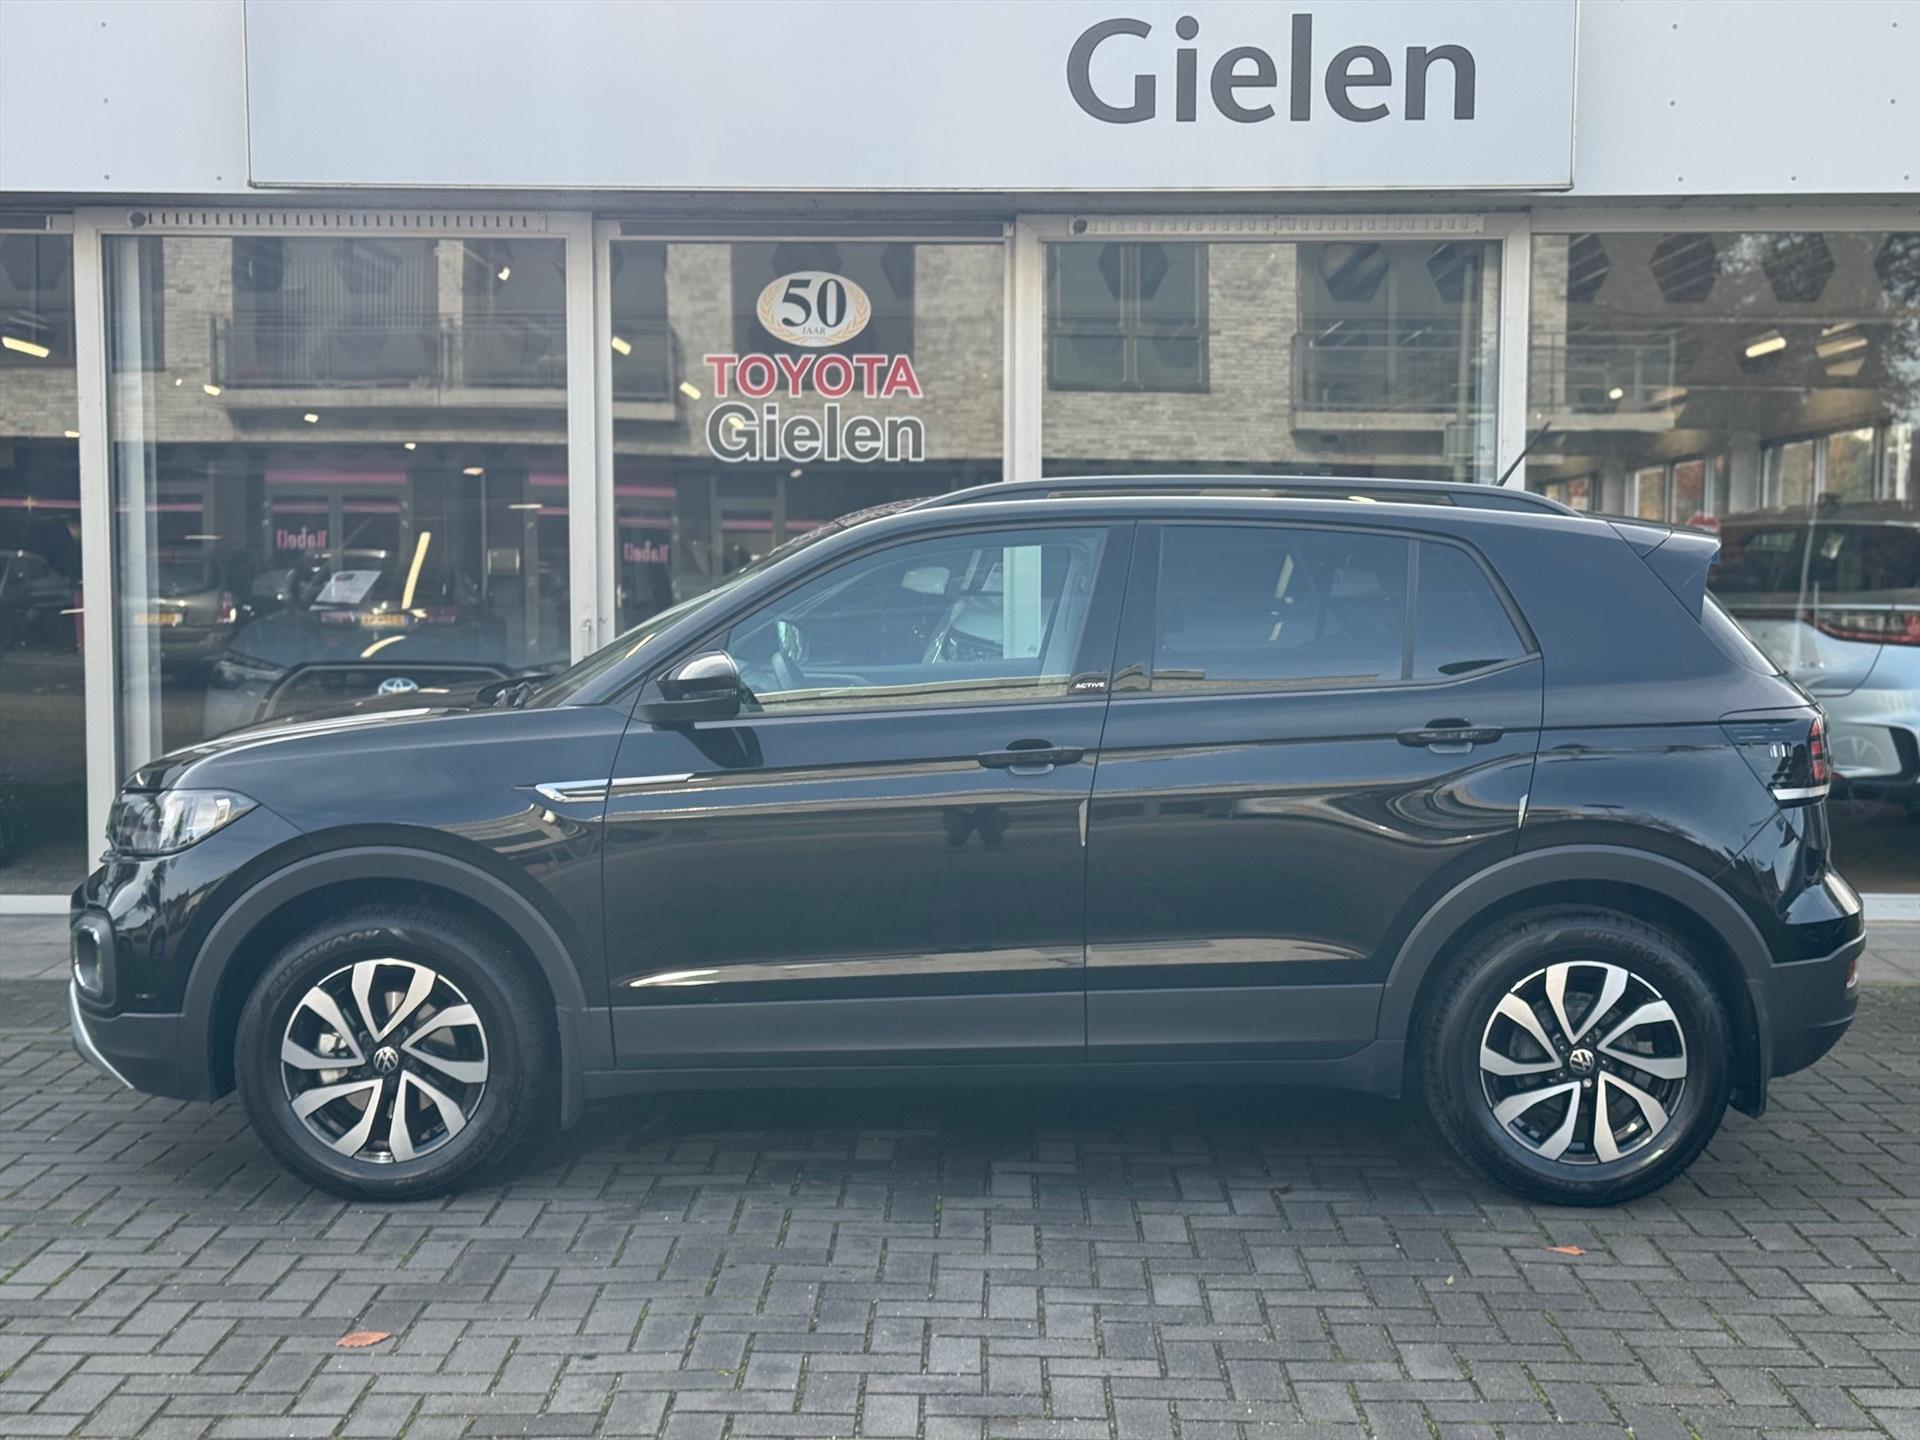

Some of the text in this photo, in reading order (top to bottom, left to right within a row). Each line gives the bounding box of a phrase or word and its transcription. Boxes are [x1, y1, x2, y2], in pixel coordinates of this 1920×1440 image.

[1066, 13, 1476, 124] Gielen
[782, 279, 847, 328] 50
[801, 327, 826, 335] JAAR
[704, 353, 924, 399] TOYOTA
[706, 401, 925, 463] Gielen
